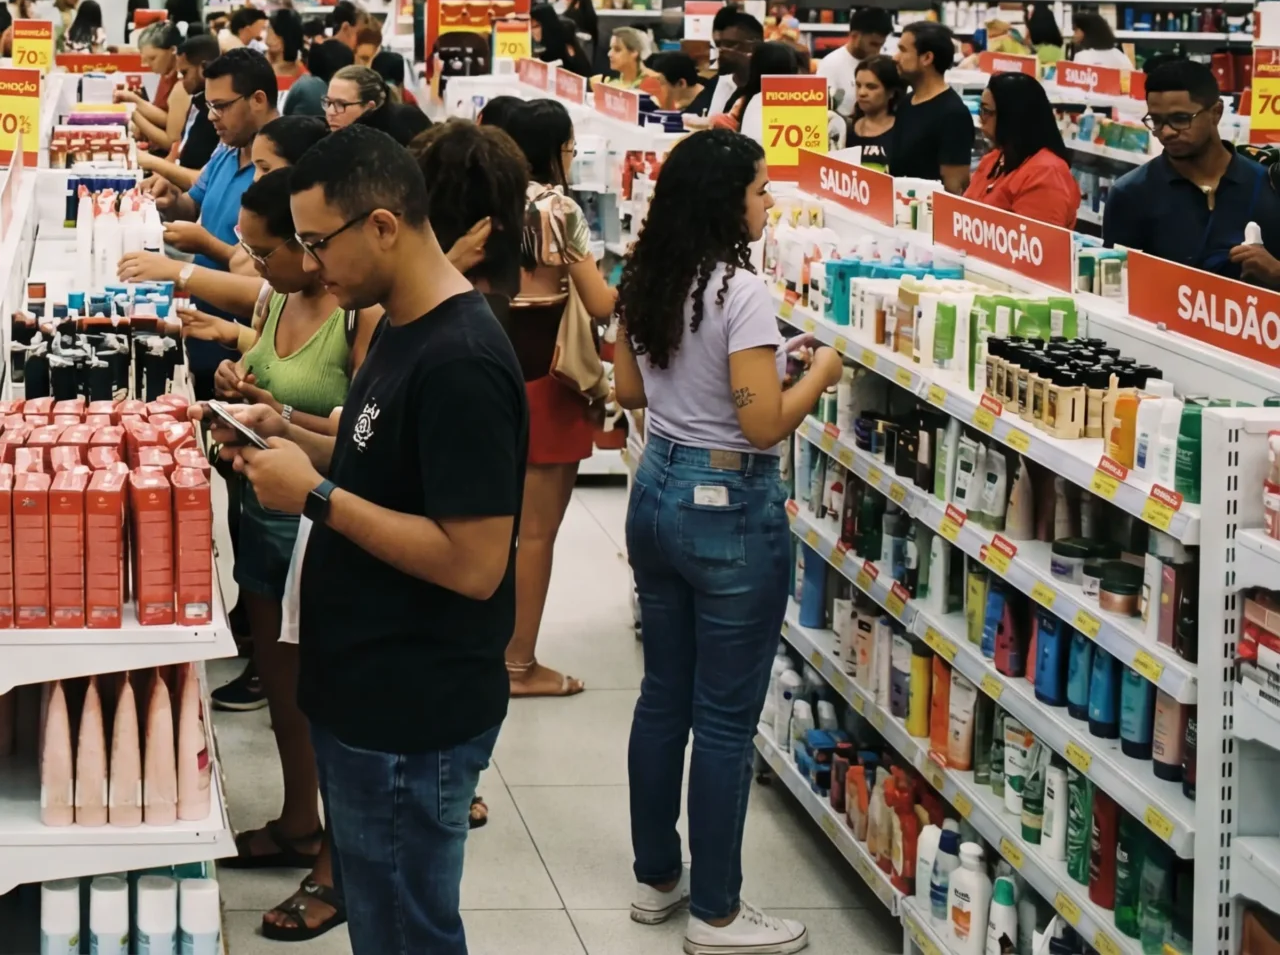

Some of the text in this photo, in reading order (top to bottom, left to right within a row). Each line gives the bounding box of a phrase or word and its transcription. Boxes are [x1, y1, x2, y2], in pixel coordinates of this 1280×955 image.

[1258, 95, 1280, 115] 70
[820, 166, 869, 205] SALDÃO
[953, 211, 1043, 266] PROMOÇÃO
[1178, 285, 1280, 349] SALDÃO
